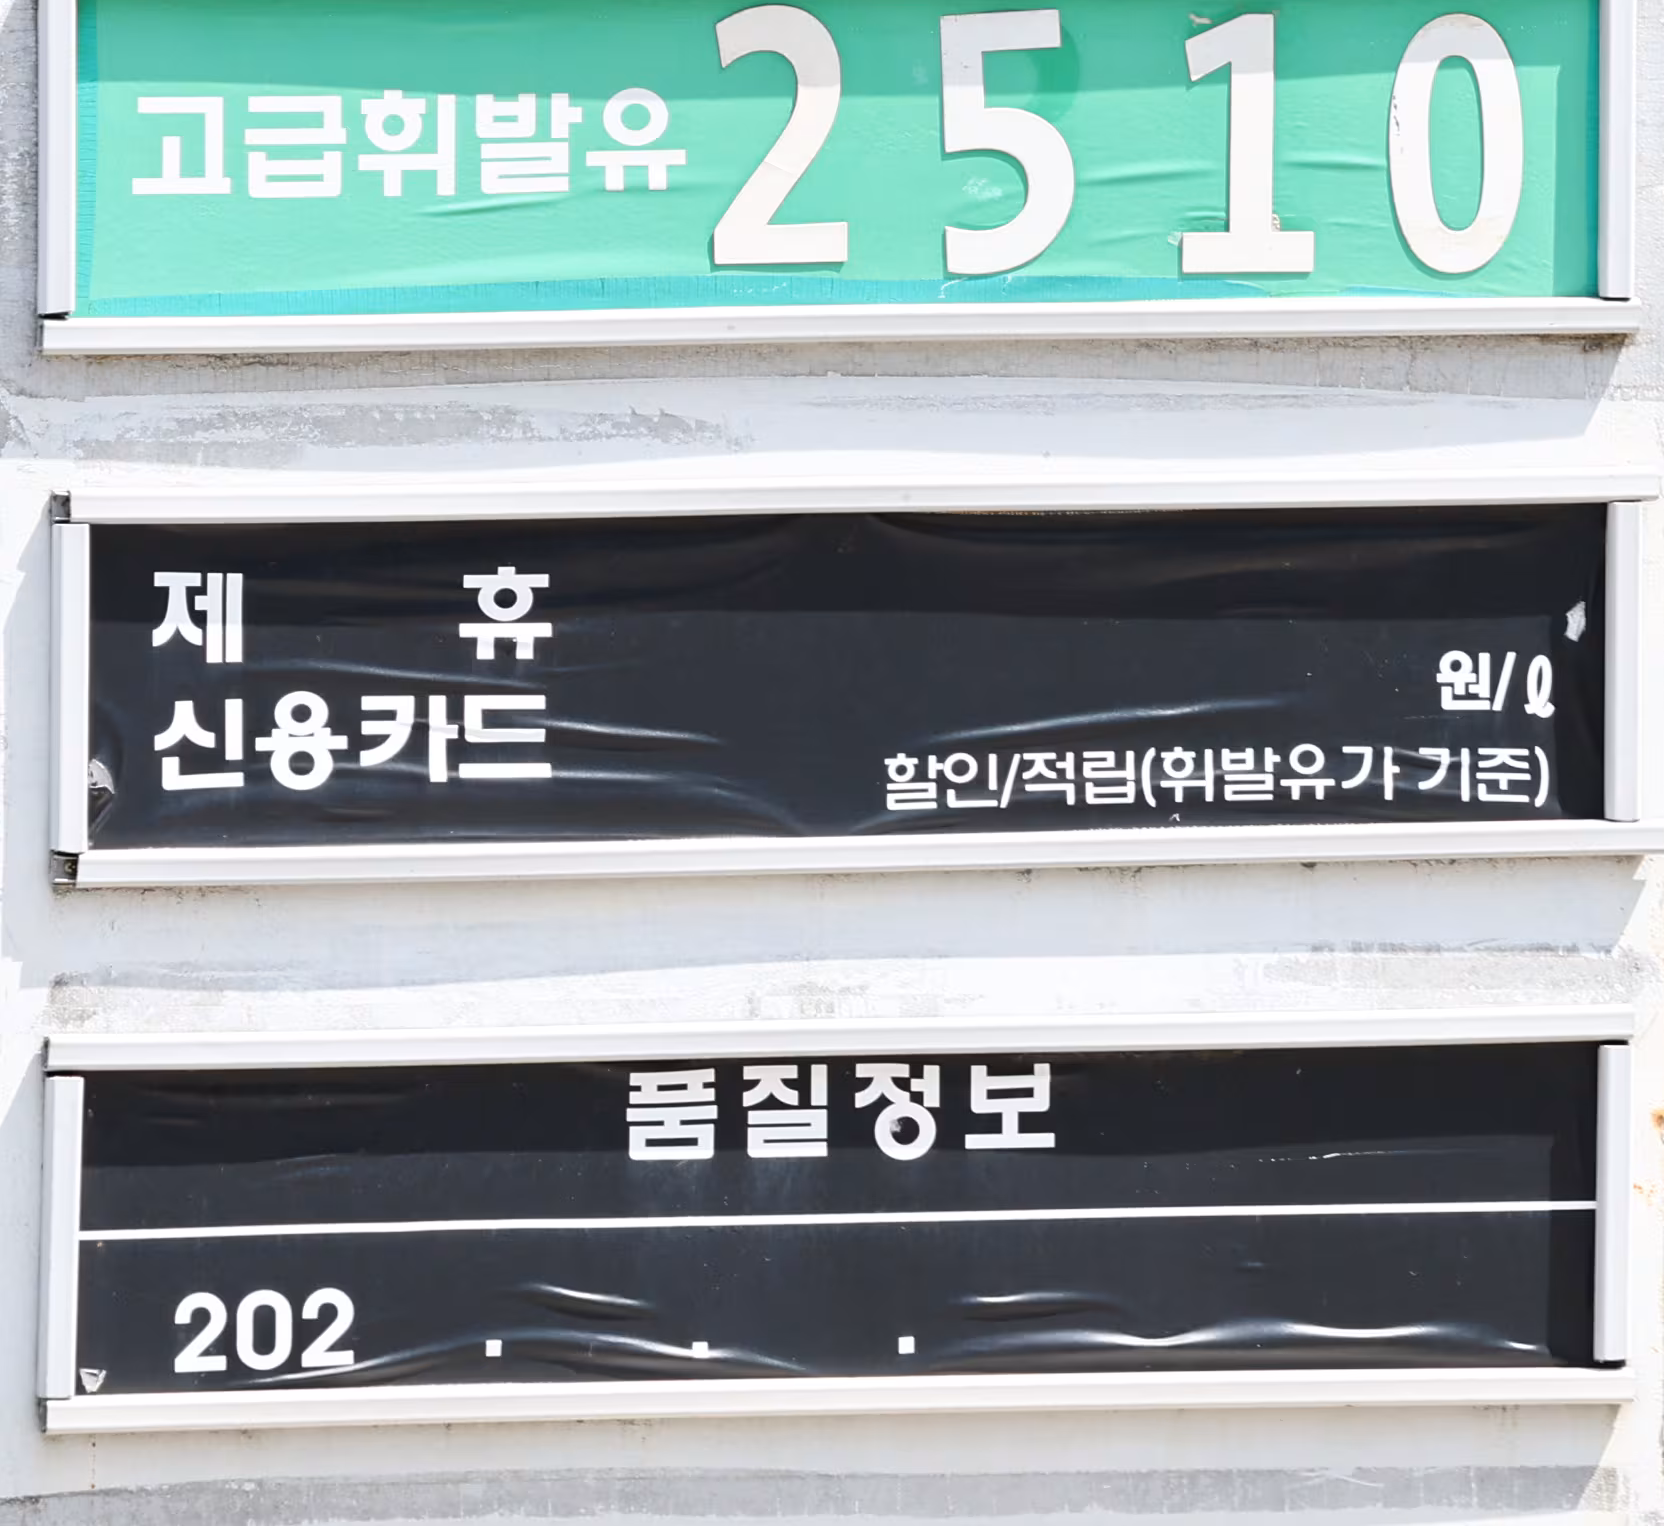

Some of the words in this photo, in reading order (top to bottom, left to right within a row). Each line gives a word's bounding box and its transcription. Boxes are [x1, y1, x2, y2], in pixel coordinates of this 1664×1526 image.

[132, 87, 687, 199] 고급휘발유
[713, 4, 1525, 276] 2510
[154, 690, 552, 792] 신용카드
[884, 743, 1401, 811] 할인/적립(휘발유가
[1417, 745, 1550, 808] 기준)
[626, 1062, 1056, 1161] 품질정보
[174, 1287, 357, 1376] 202
